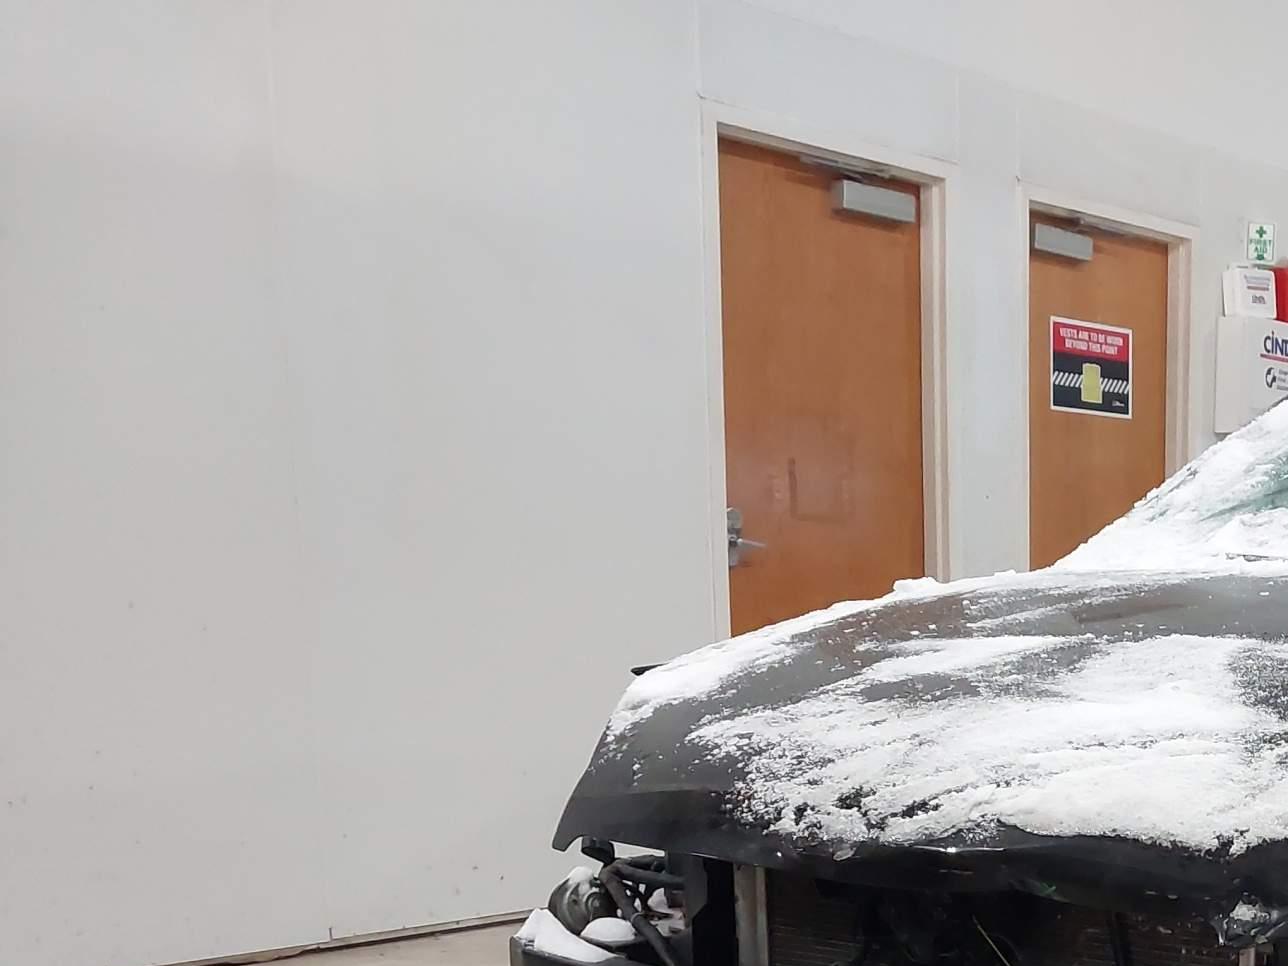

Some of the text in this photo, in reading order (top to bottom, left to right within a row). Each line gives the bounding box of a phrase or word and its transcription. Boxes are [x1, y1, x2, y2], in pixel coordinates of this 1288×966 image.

[1254, 246, 1267, 254] AID
[1059, 327, 1123, 346] VESTS ARE TO BE WORN
[1065, 338, 1118, 355] BEYOND THIS POINT
